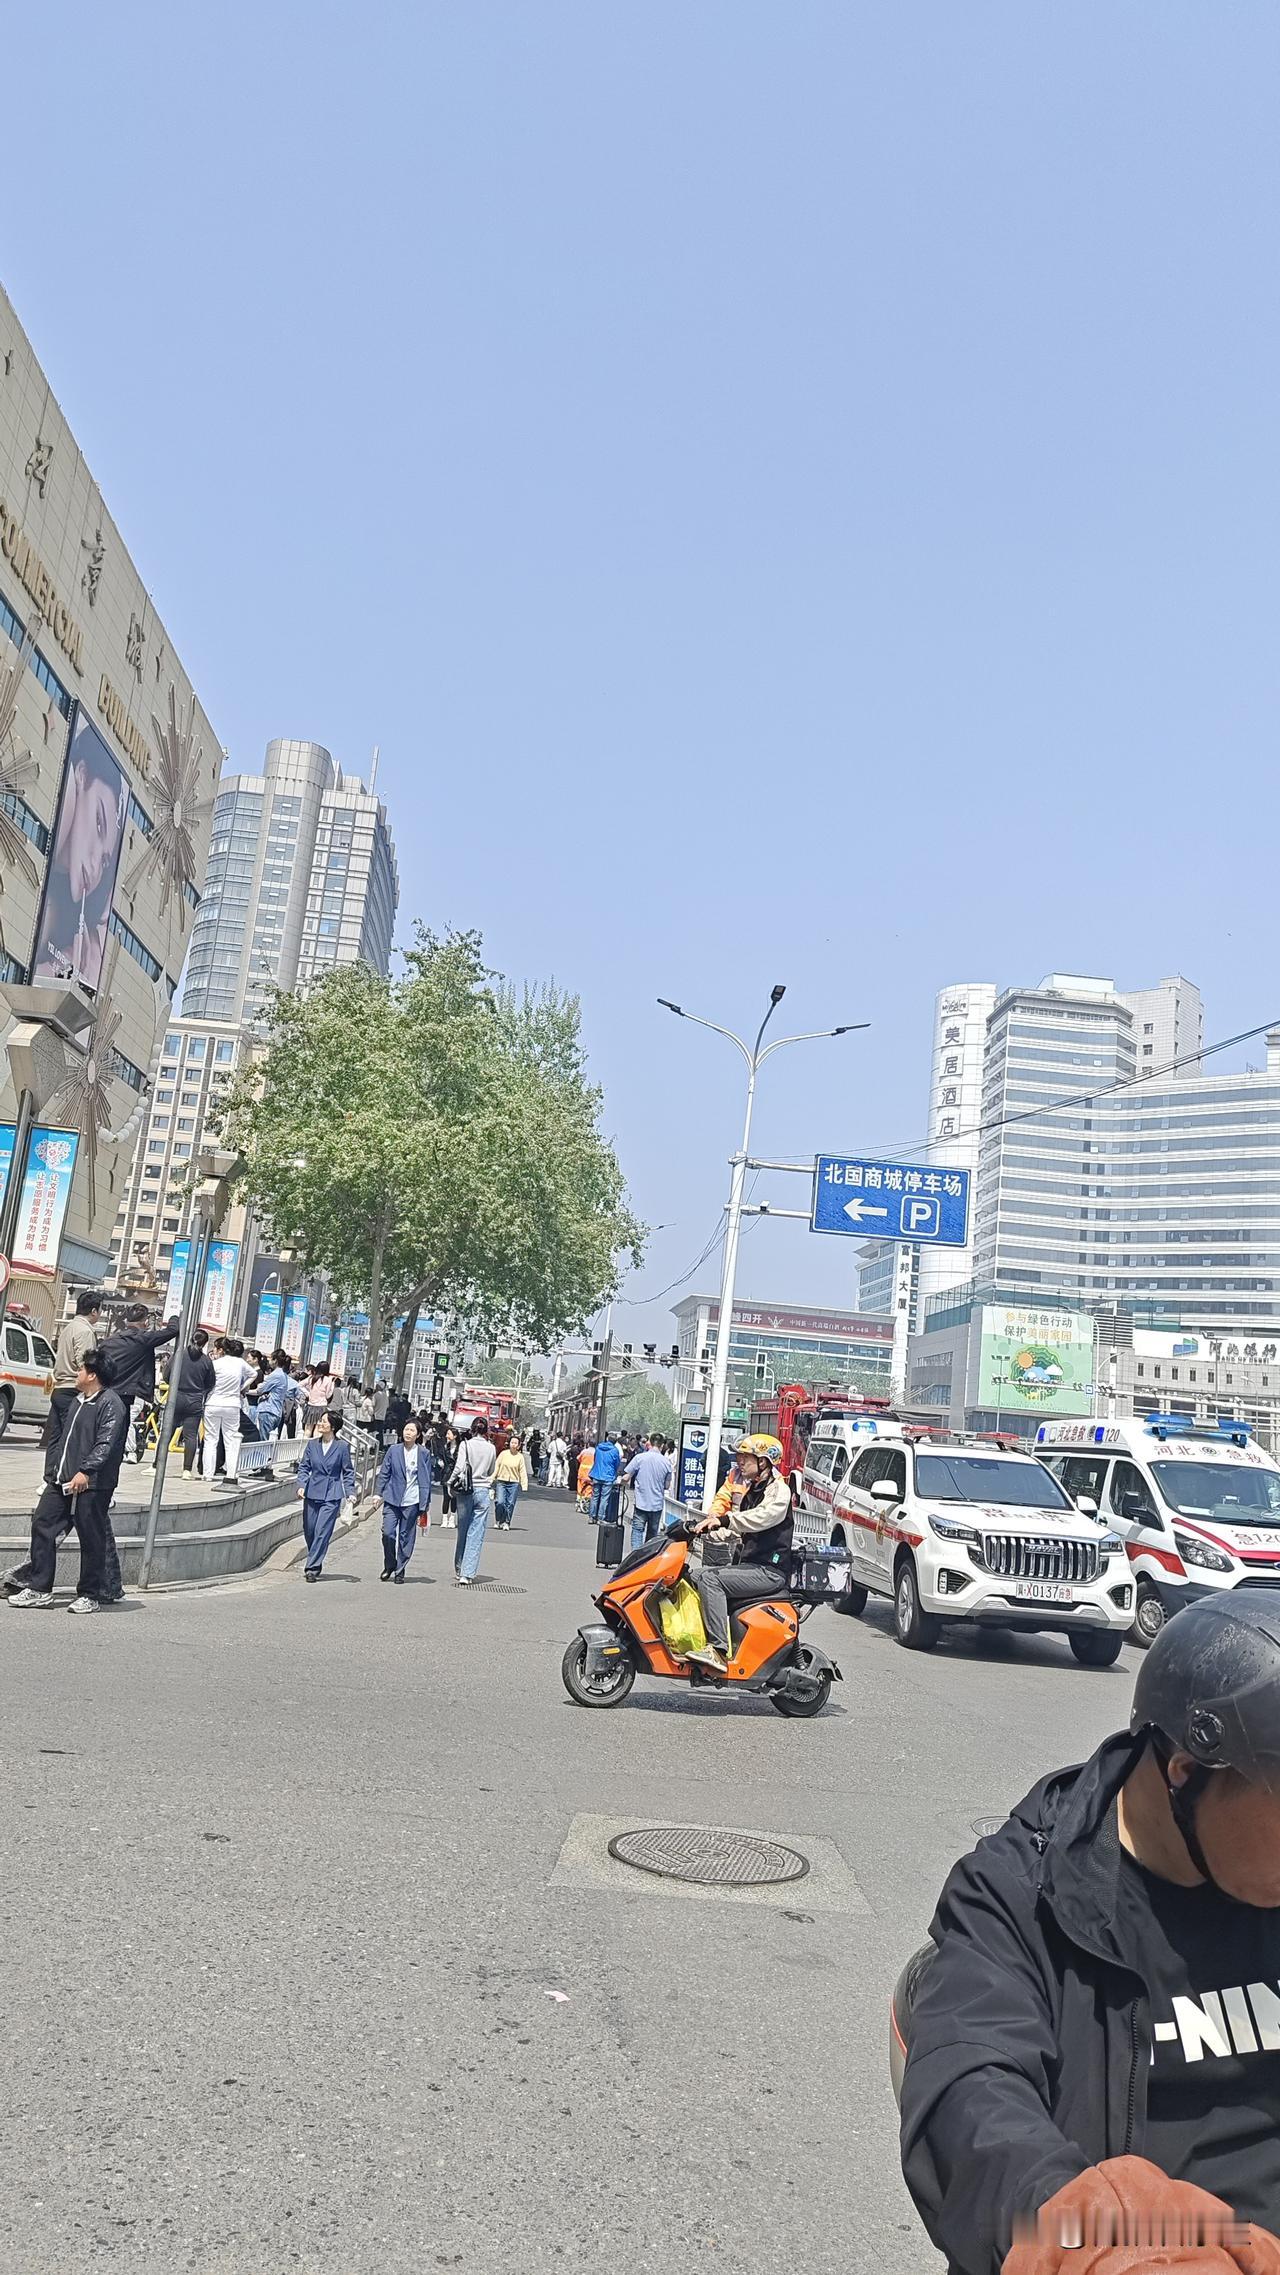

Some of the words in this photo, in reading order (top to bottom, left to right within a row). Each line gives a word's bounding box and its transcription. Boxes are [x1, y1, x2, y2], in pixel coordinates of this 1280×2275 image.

[97, 672, 152, 782] BUILDING
[940, 1026, 960, 1135] 美居酒店
[824, 1163, 962, 1196] 北国商城停车场
[25, 1170, 46, 1251] 让志愿服务成为时尚
[38, 1173, 60, 1252] 让文明行为成为习惯
[910, 1202, 932, 1229] P
[898, 1244, 910, 1310] 富邦大厦
[1004, 1325, 1072, 1342] 保护美丽家园
[1006, 1312, 1072, 1328] 参与绿色行动
[1057, 1425, 1086, 1441] 河北急救
[1105, 1428, 1120, 1442] 120
[1154, 1445, 1196, 1456] 河北
[1226, 1449, 1264, 1465] 急救
